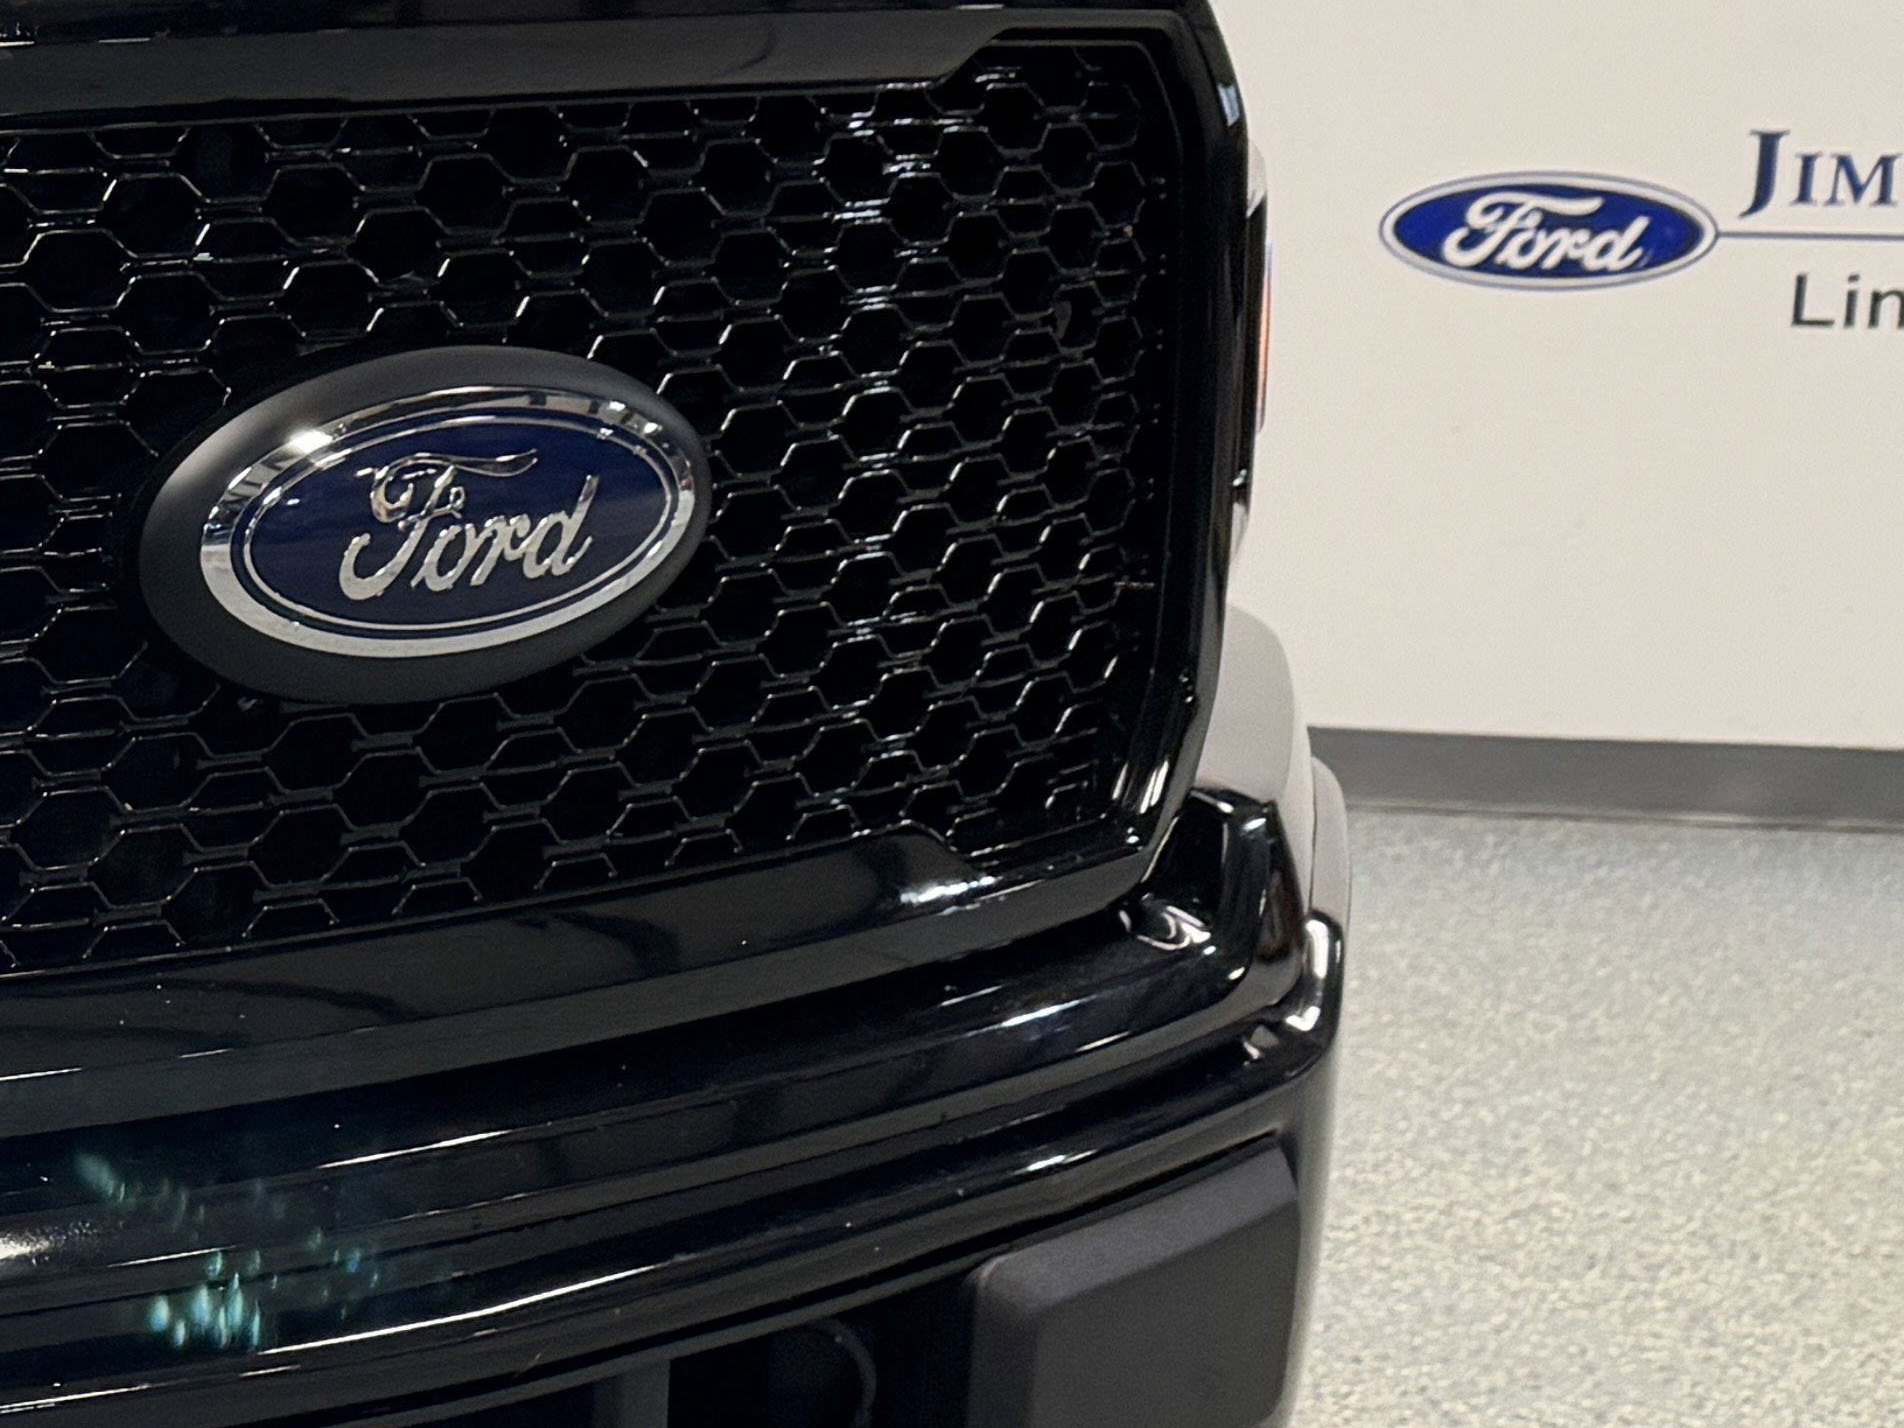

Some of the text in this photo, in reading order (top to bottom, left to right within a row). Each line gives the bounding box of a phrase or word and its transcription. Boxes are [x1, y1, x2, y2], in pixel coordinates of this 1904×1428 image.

[1737, 128, 1903, 220] JIM
[1441, 190, 1652, 273] Ford
[1791, 271, 1904, 329] Lin
[338, 447, 602, 602] Ford
